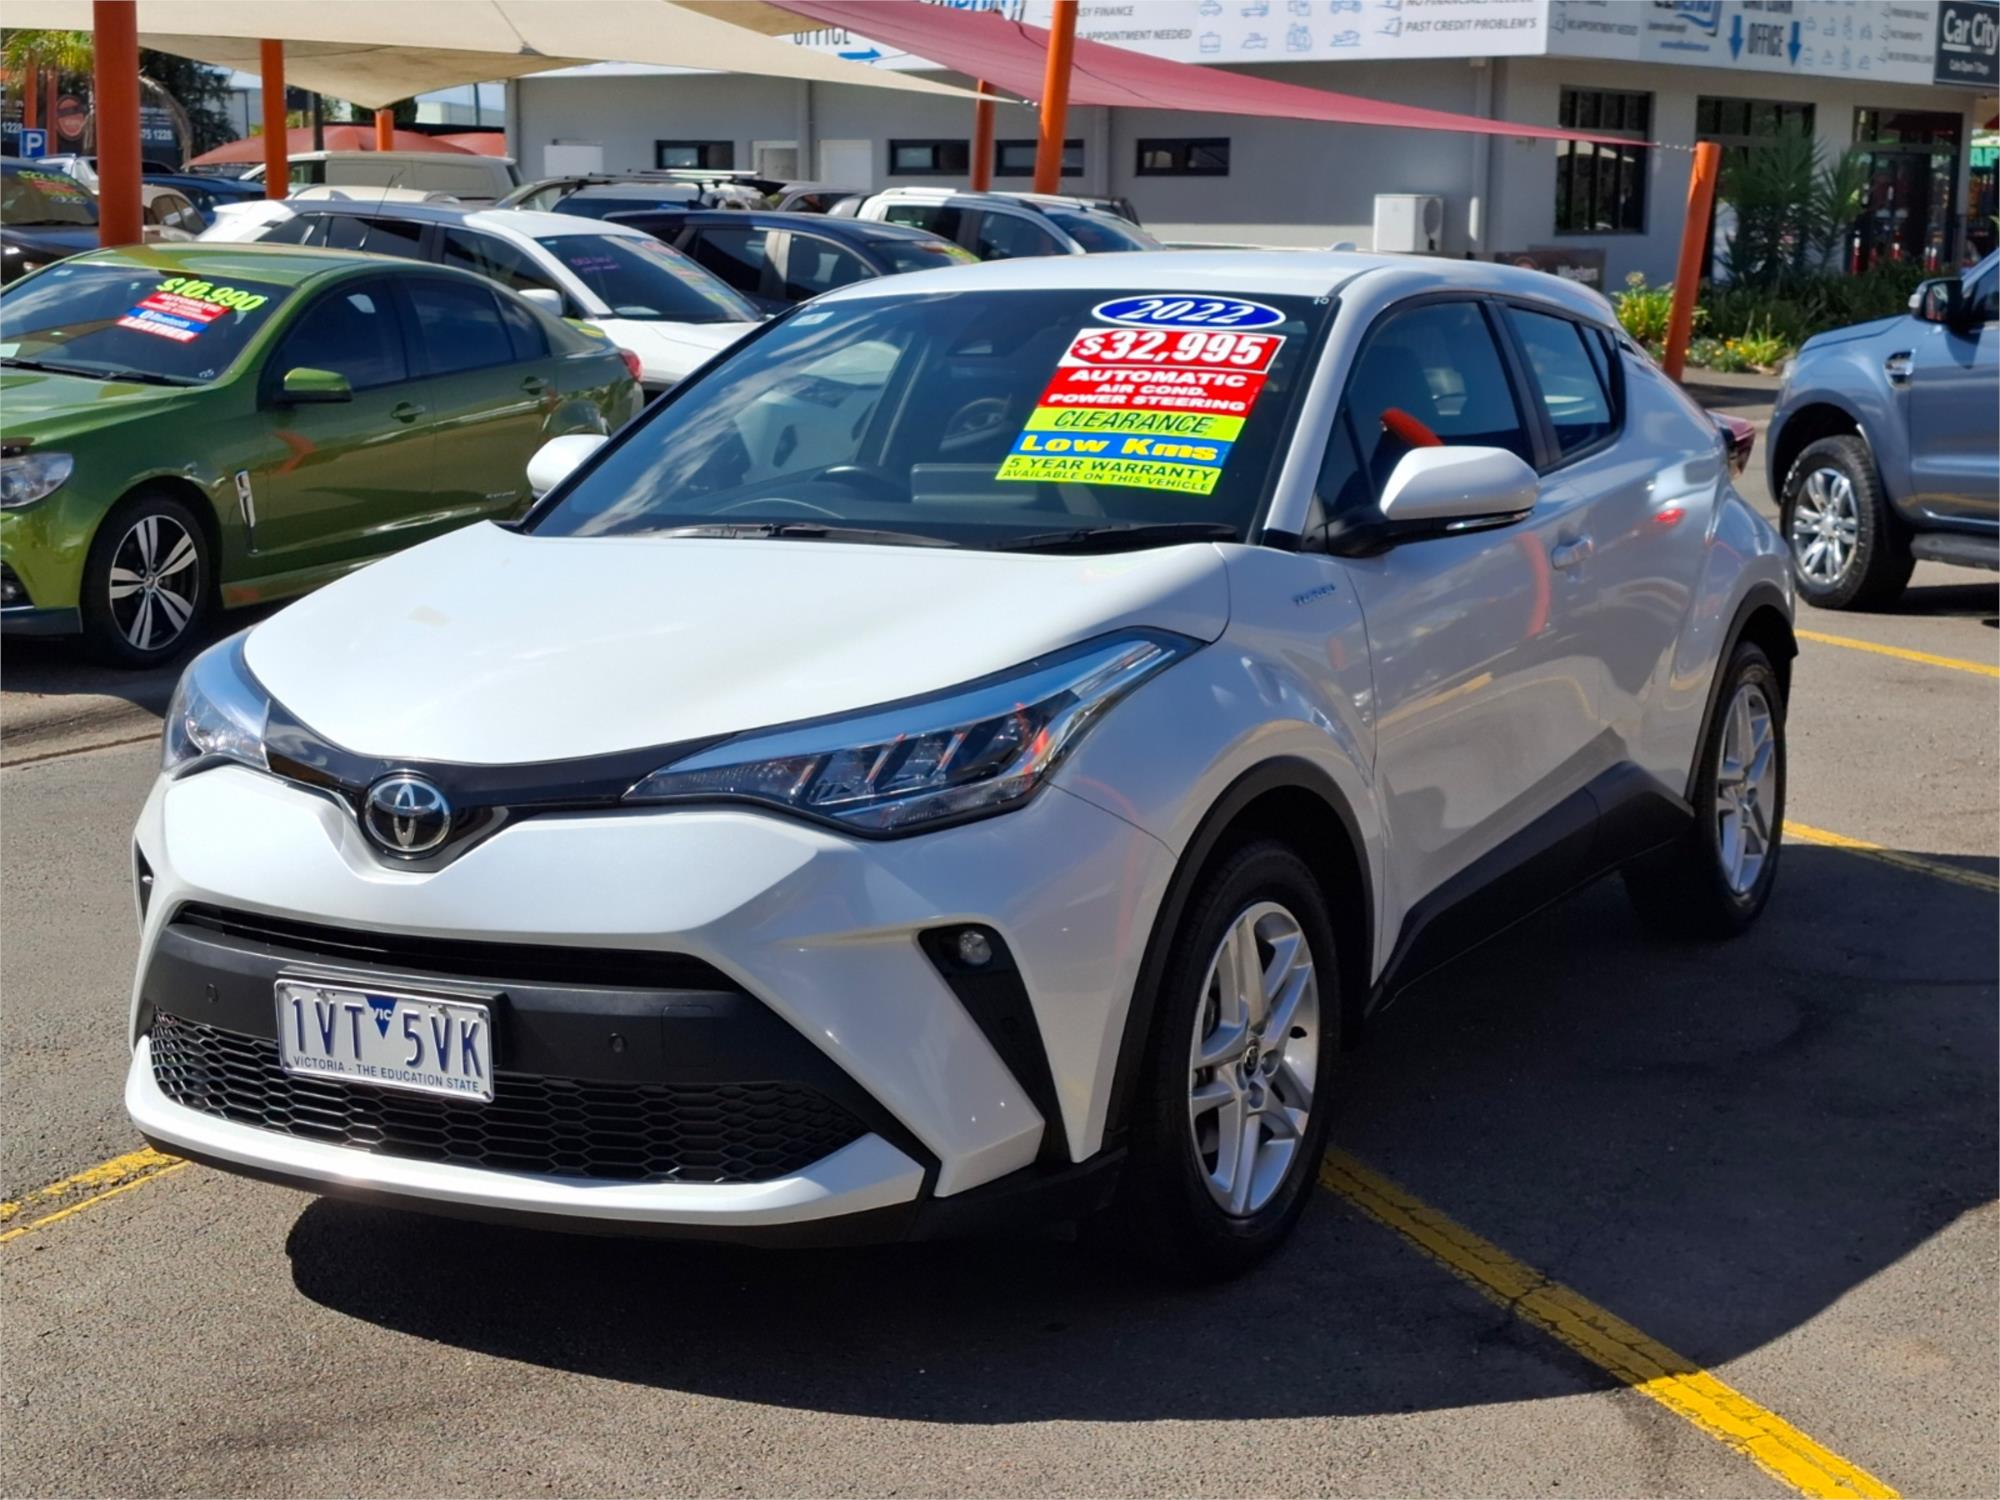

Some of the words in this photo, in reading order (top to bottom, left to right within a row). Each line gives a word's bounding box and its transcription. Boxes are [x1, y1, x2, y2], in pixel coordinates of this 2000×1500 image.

[1094, 6, 1134, 16] FINANCE
[1086, 30, 1152, 40] APPOINTMENT
[1153, 28, 1193, 39] NEEDED
[1405, 21, 1432, 32] PAST
[1433, 19, 1472, 31] CREDIT
[1474, 17, 1537, 30] PROBLEM'S
[1747, 22, 1784, 57] OFFICE
[26, 132, 43, 156] P
[1115, 299, 1255, 324] 2022
[1077, 330, 1269, 365] $32,995
[1068, 369, 1248, 388] AUTOMATIC
[1095, 383, 1135, 394] AIR
[1140, 384, 1208, 397] COND.
[1047, 393, 1128, 405] POWER
[1131, 395, 1246, 411] STEERING
[1053, 410, 1215, 434] CLEARANCE
[1019, 435, 1110, 453] Low
[1120, 438, 1219, 461] Kms
[1002, 469, 1080, 480] AVAILABLE
[1083, 472, 1105, 481] ON
[1109, 473, 1142, 484] THIS
[1147, 476, 1210, 491] VEHICLE
[1008, 457, 1023, 469] 5
[1029, 458, 1083, 470] YEAR
[1085, 460, 1215, 481] WARRANTY
[372, 1007, 393, 1021] VIC
[291, 996, 366, 1060] 1VT
[401, 1009, 484, 1078] 5VK
[293, 1055, 344, 1071] VICTORIA
[356, 1063, 377, 1076] THE
[381, 1067, 443, 1087] EDUCATION
[446, 1078, 479, 1092] STATE
